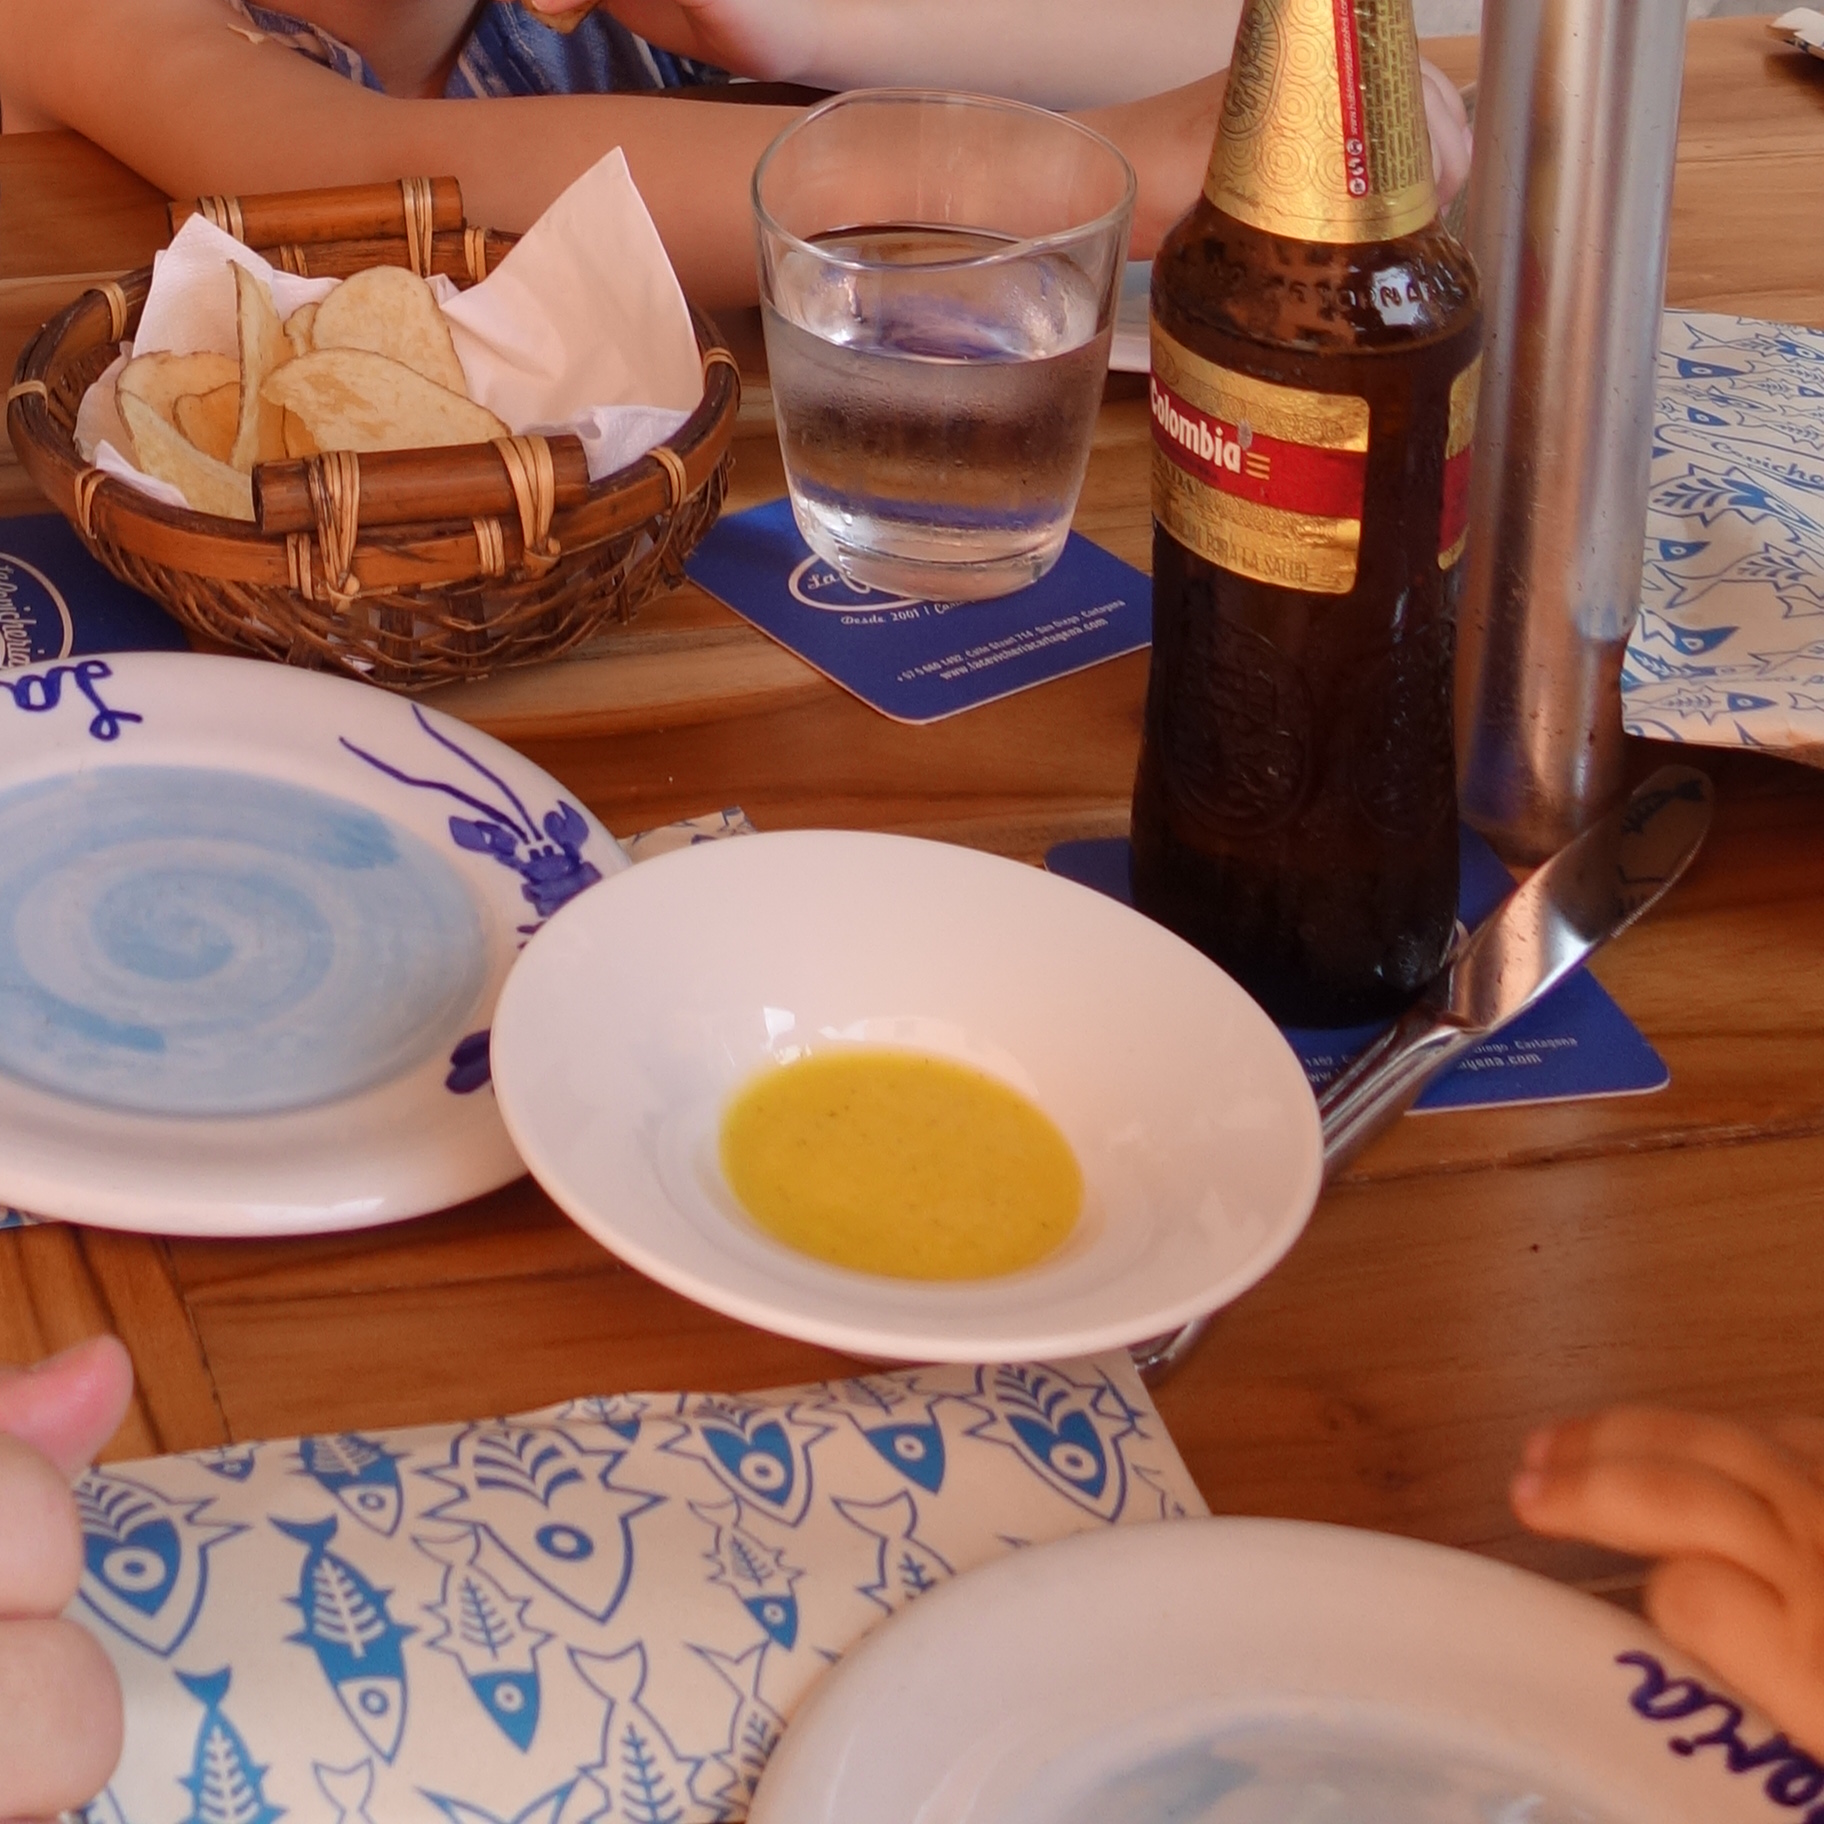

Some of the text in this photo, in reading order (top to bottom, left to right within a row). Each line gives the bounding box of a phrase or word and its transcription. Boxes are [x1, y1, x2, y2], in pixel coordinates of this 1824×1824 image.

[1151, 375, 1242, 474] Colombia
[806, 573, 839, 590] La
[840, 614, 886, 625] Desde
[889, 607, 921, 622] 2001
